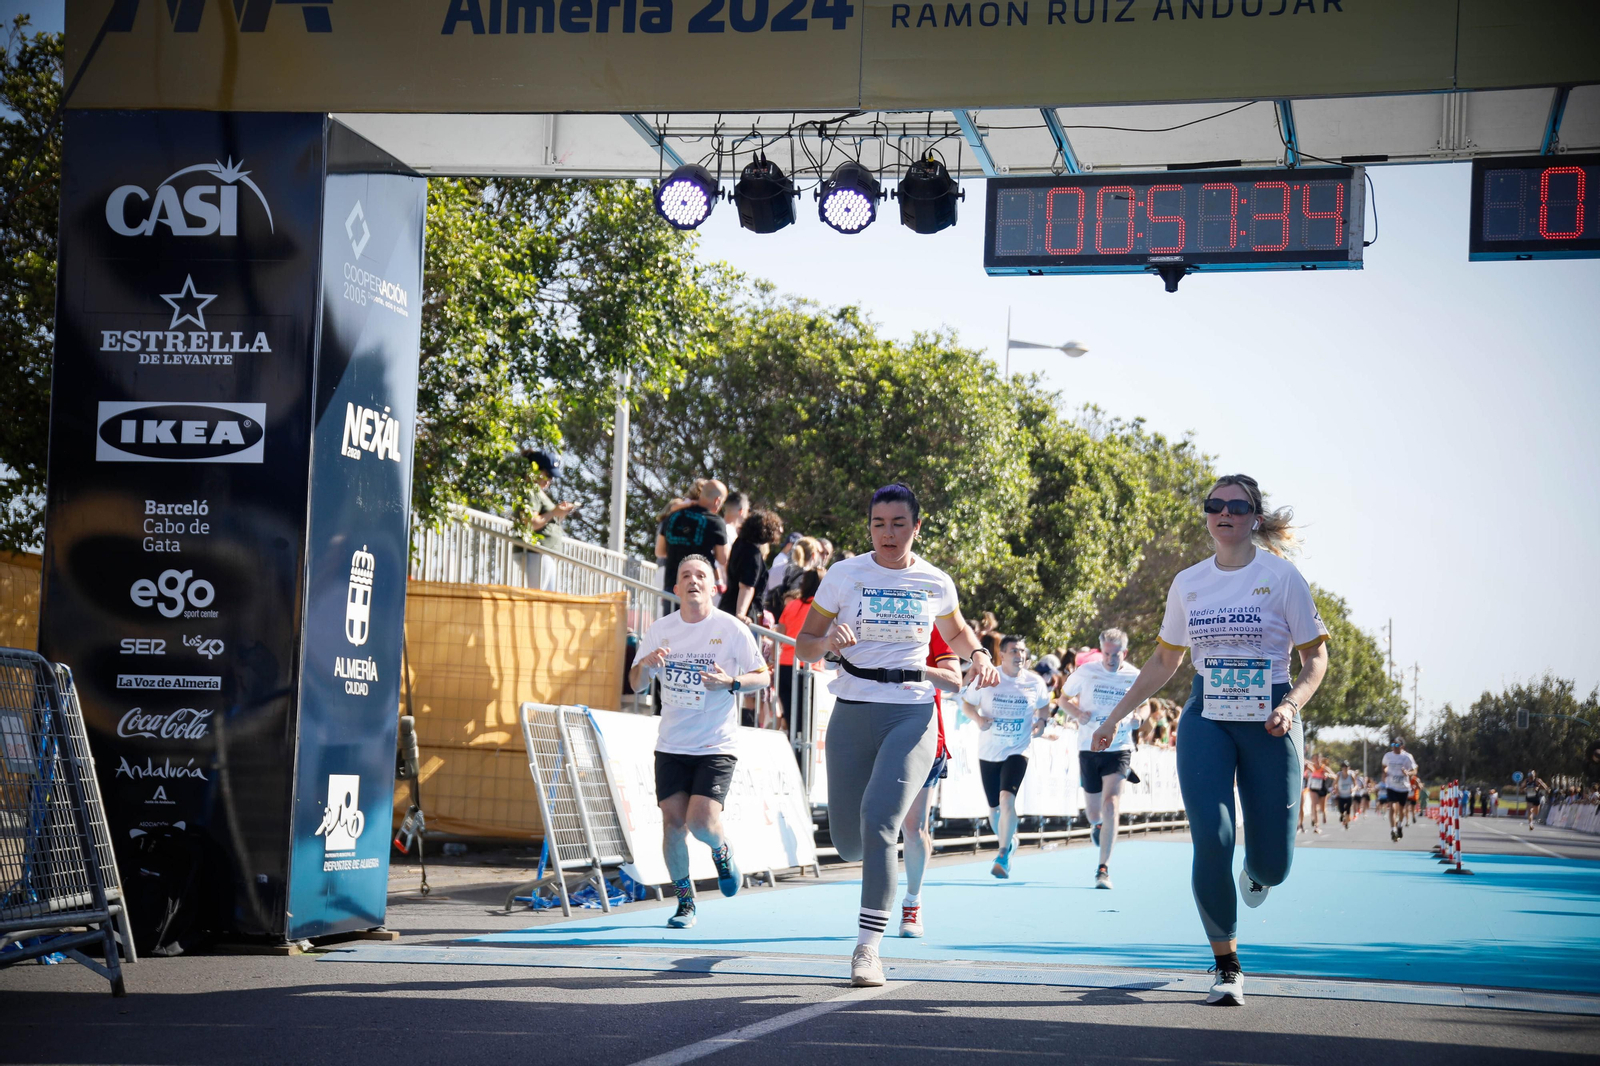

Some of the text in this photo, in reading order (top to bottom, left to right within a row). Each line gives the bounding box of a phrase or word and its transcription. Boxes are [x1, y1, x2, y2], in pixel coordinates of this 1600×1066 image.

[688, 0, 854, 33] 2024
[1047, 0, 1136, 25] RUIZ
[105, 184, 238, 237] CASI
[343, 261, 408, 307] COOPERACIÓN
[343, 281, 367, 307] 2005
[100, 330, 272, 353] ESTRELLA
[138, 353, 233, 366] DE LEVANTE
[120, 419, 246, 445] IKEA
[347, 446, 362, 461] 2020
[144, 499, 209, 516] Barceló
[143, 518, 210, 534] Cabo de
[142, 536, 181, 552] Gata
[130, 568, 215, 618] ego
[184, 609, 219, 619] sport center
[869, 597, 922, 616] 5429
[1190, 605, 1261, 617] Medio Maratón
[1188, 614, 1262, 627] Almería 2024
[1229, 625, 1263, 633] ANDÚJAR
[120, 638, 166, 655] SER
[686, 651, 716, 659] Maratón
[334, 655, 379, 682] ALMERÍA
[665, 668, 702, 686] 5739
[118, 677, 219, 689] La Voz de Almería
[1210, 668, 1266, 689] 5454
[345, 680, 369, 696] CIUDAD
[996, 722, 1022, 732] 5630
[115, 755, 209, 781] Andalucía
